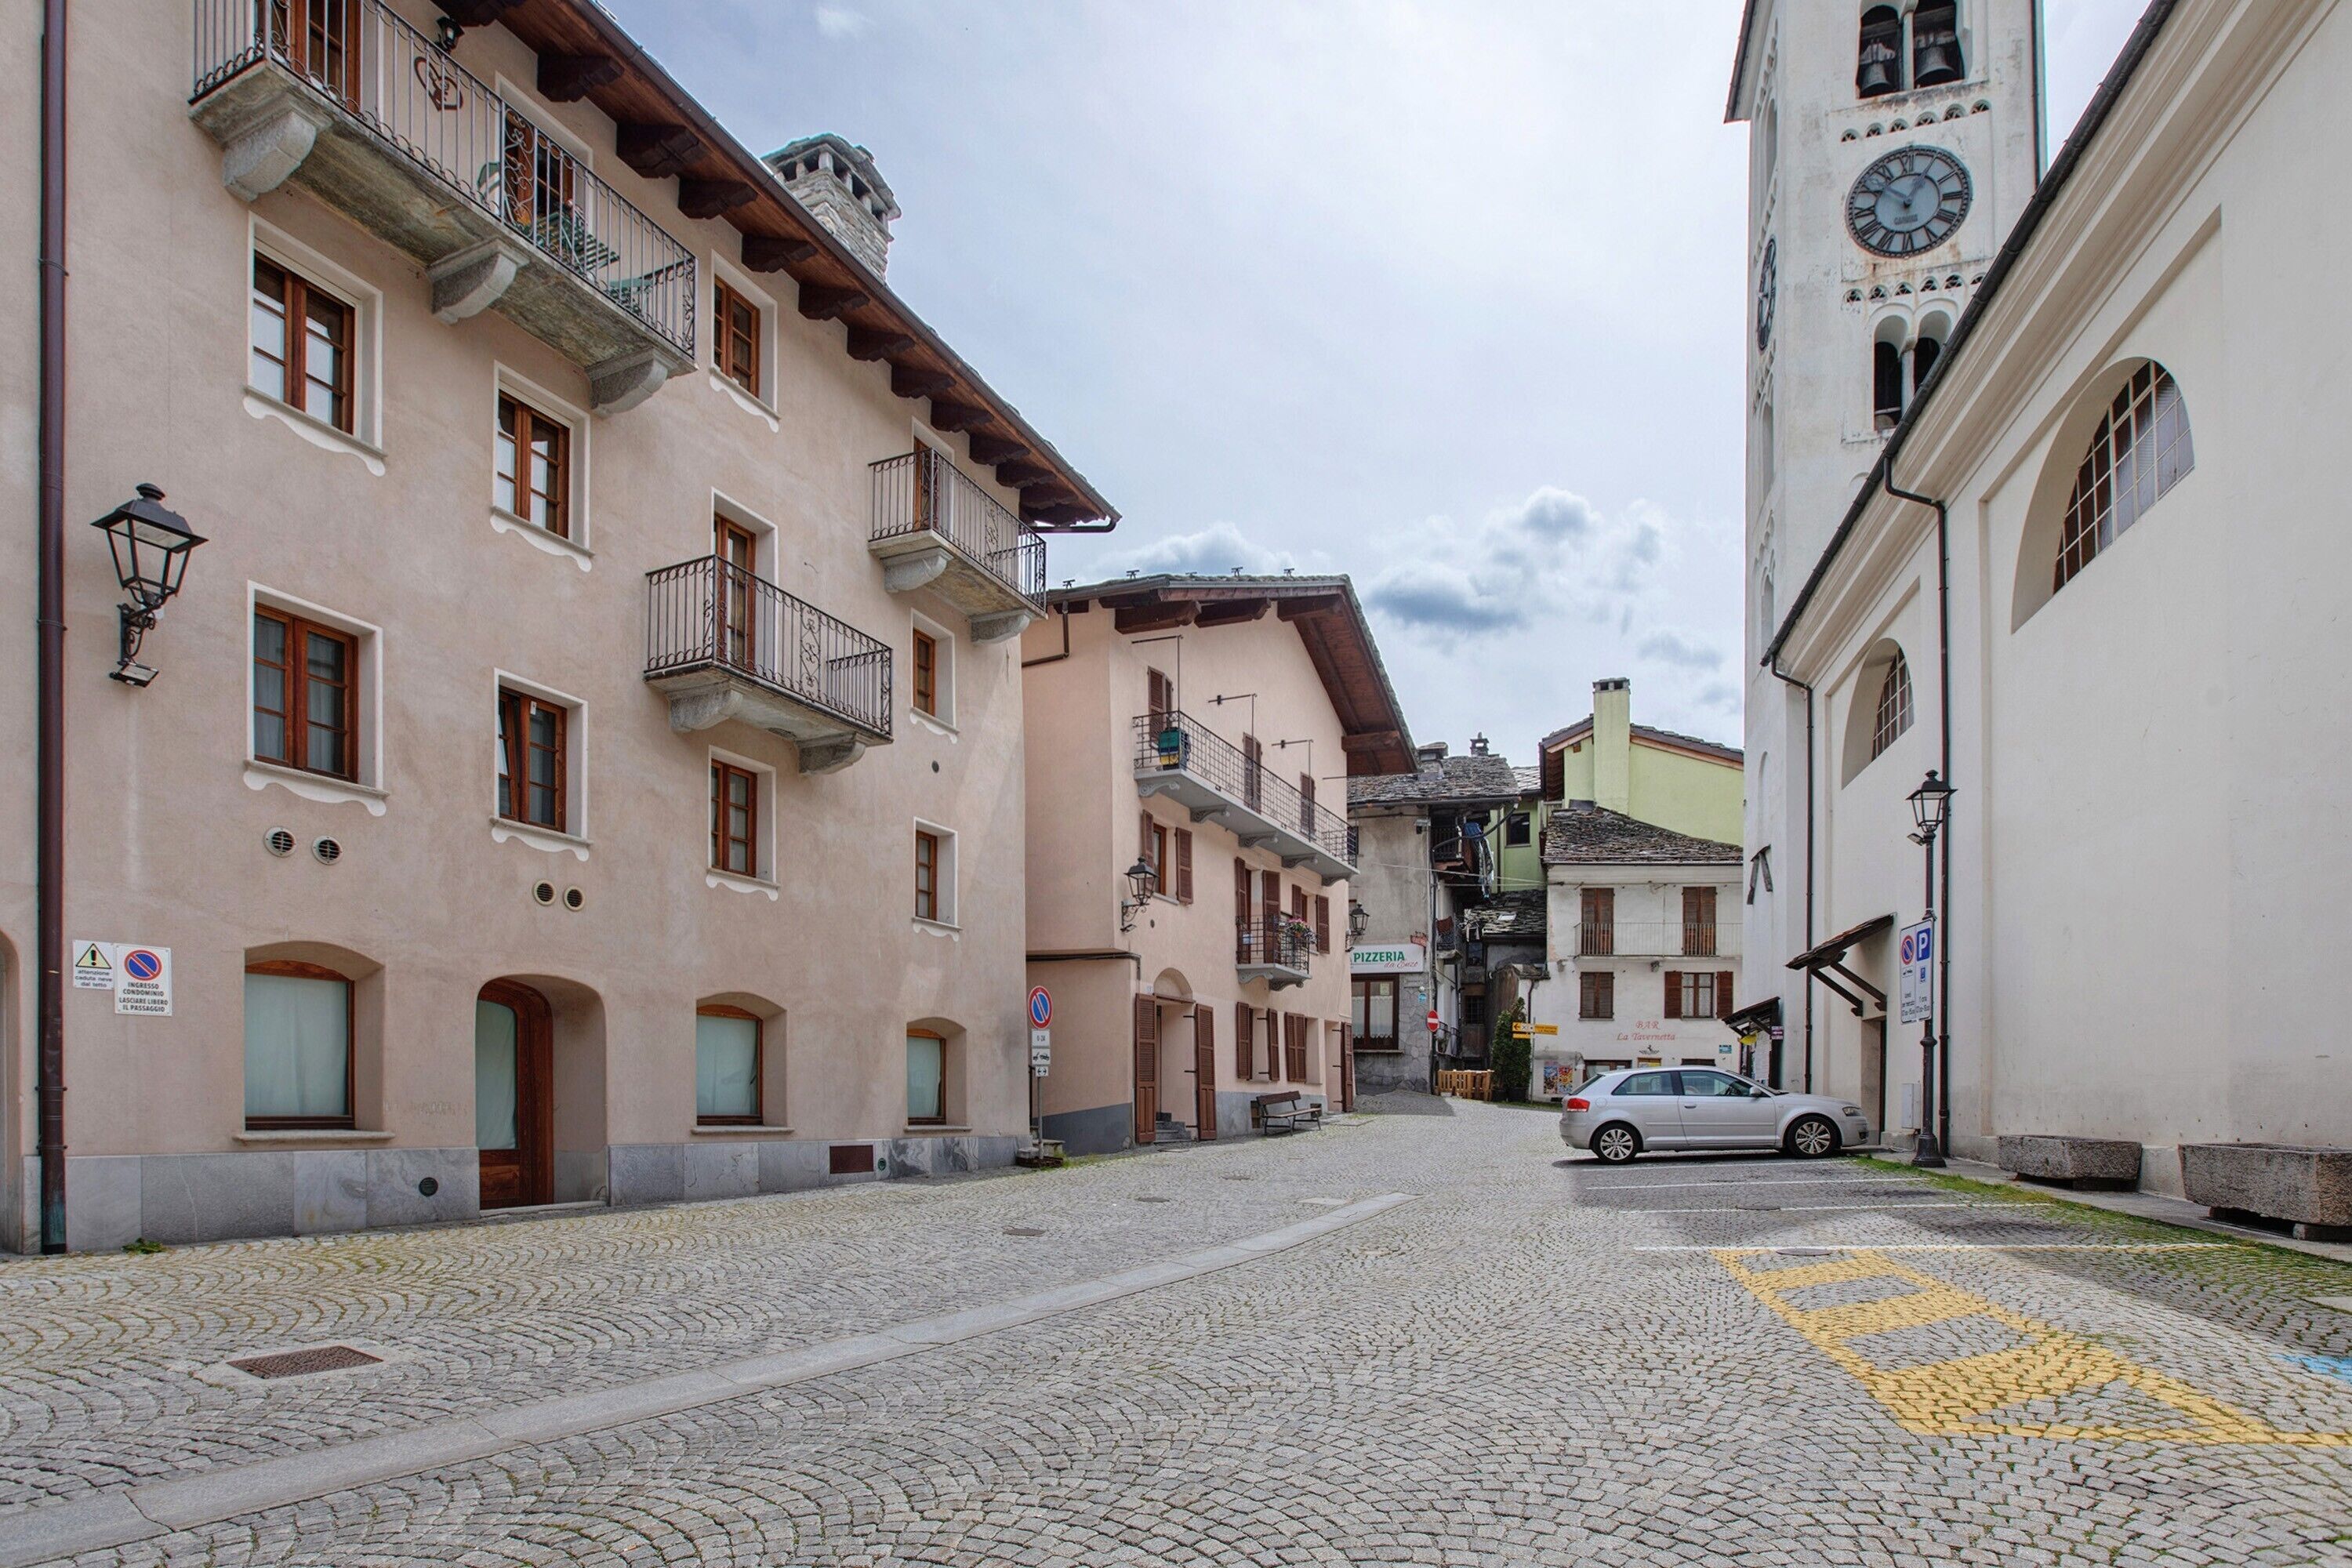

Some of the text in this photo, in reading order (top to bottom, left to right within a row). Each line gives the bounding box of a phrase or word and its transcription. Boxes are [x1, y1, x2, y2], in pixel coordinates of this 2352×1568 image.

[1918, 932, 1929, 958] P
[1353, 951, 1406, 963] PIZZERIA
[1635, 1020, 1661, 1029] BAR
[1632, 1033, 1675, 1041] Tavernetta
